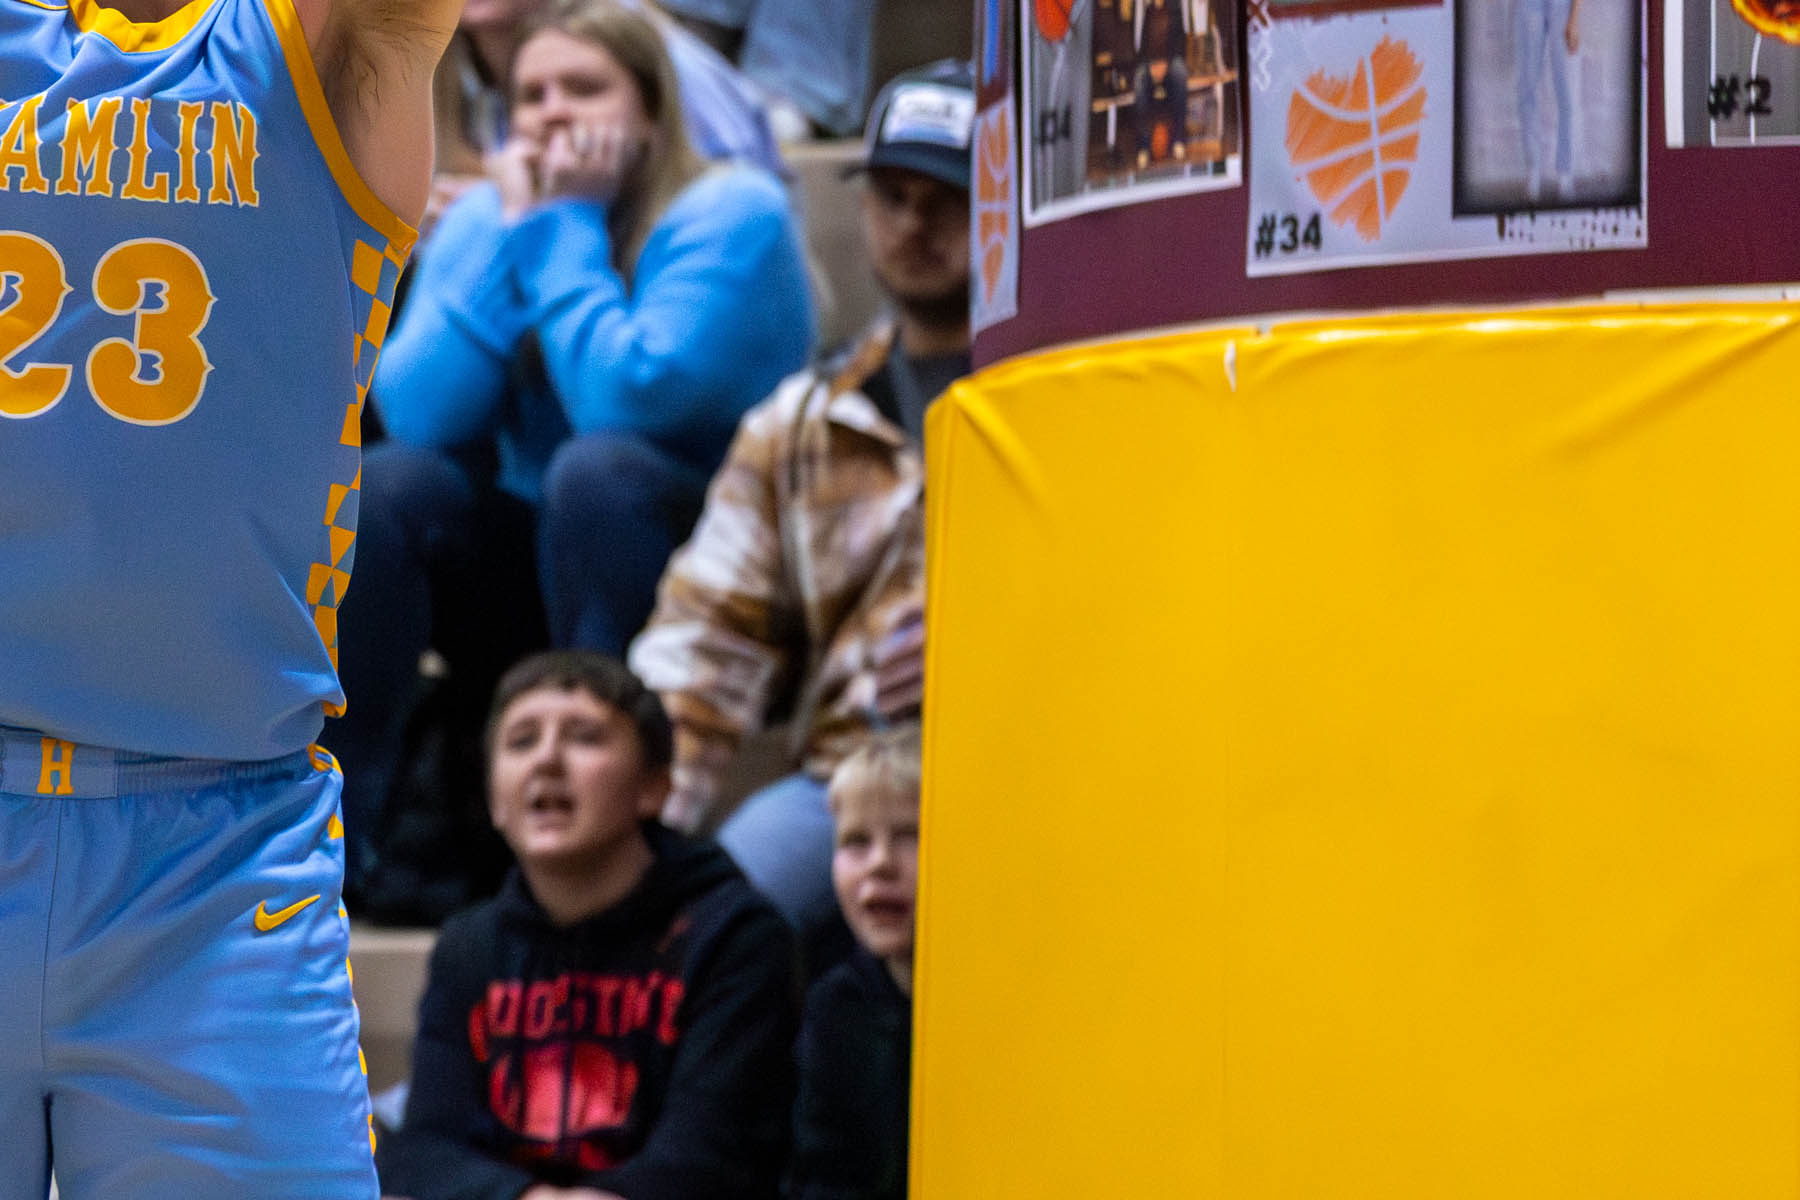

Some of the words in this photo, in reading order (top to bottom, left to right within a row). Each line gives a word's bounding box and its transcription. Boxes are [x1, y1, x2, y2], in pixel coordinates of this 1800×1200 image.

[1707, 73, 1773, 120] #2
[1255, 211, 1322, 259] #34
[36, 737, 76, 796] H
